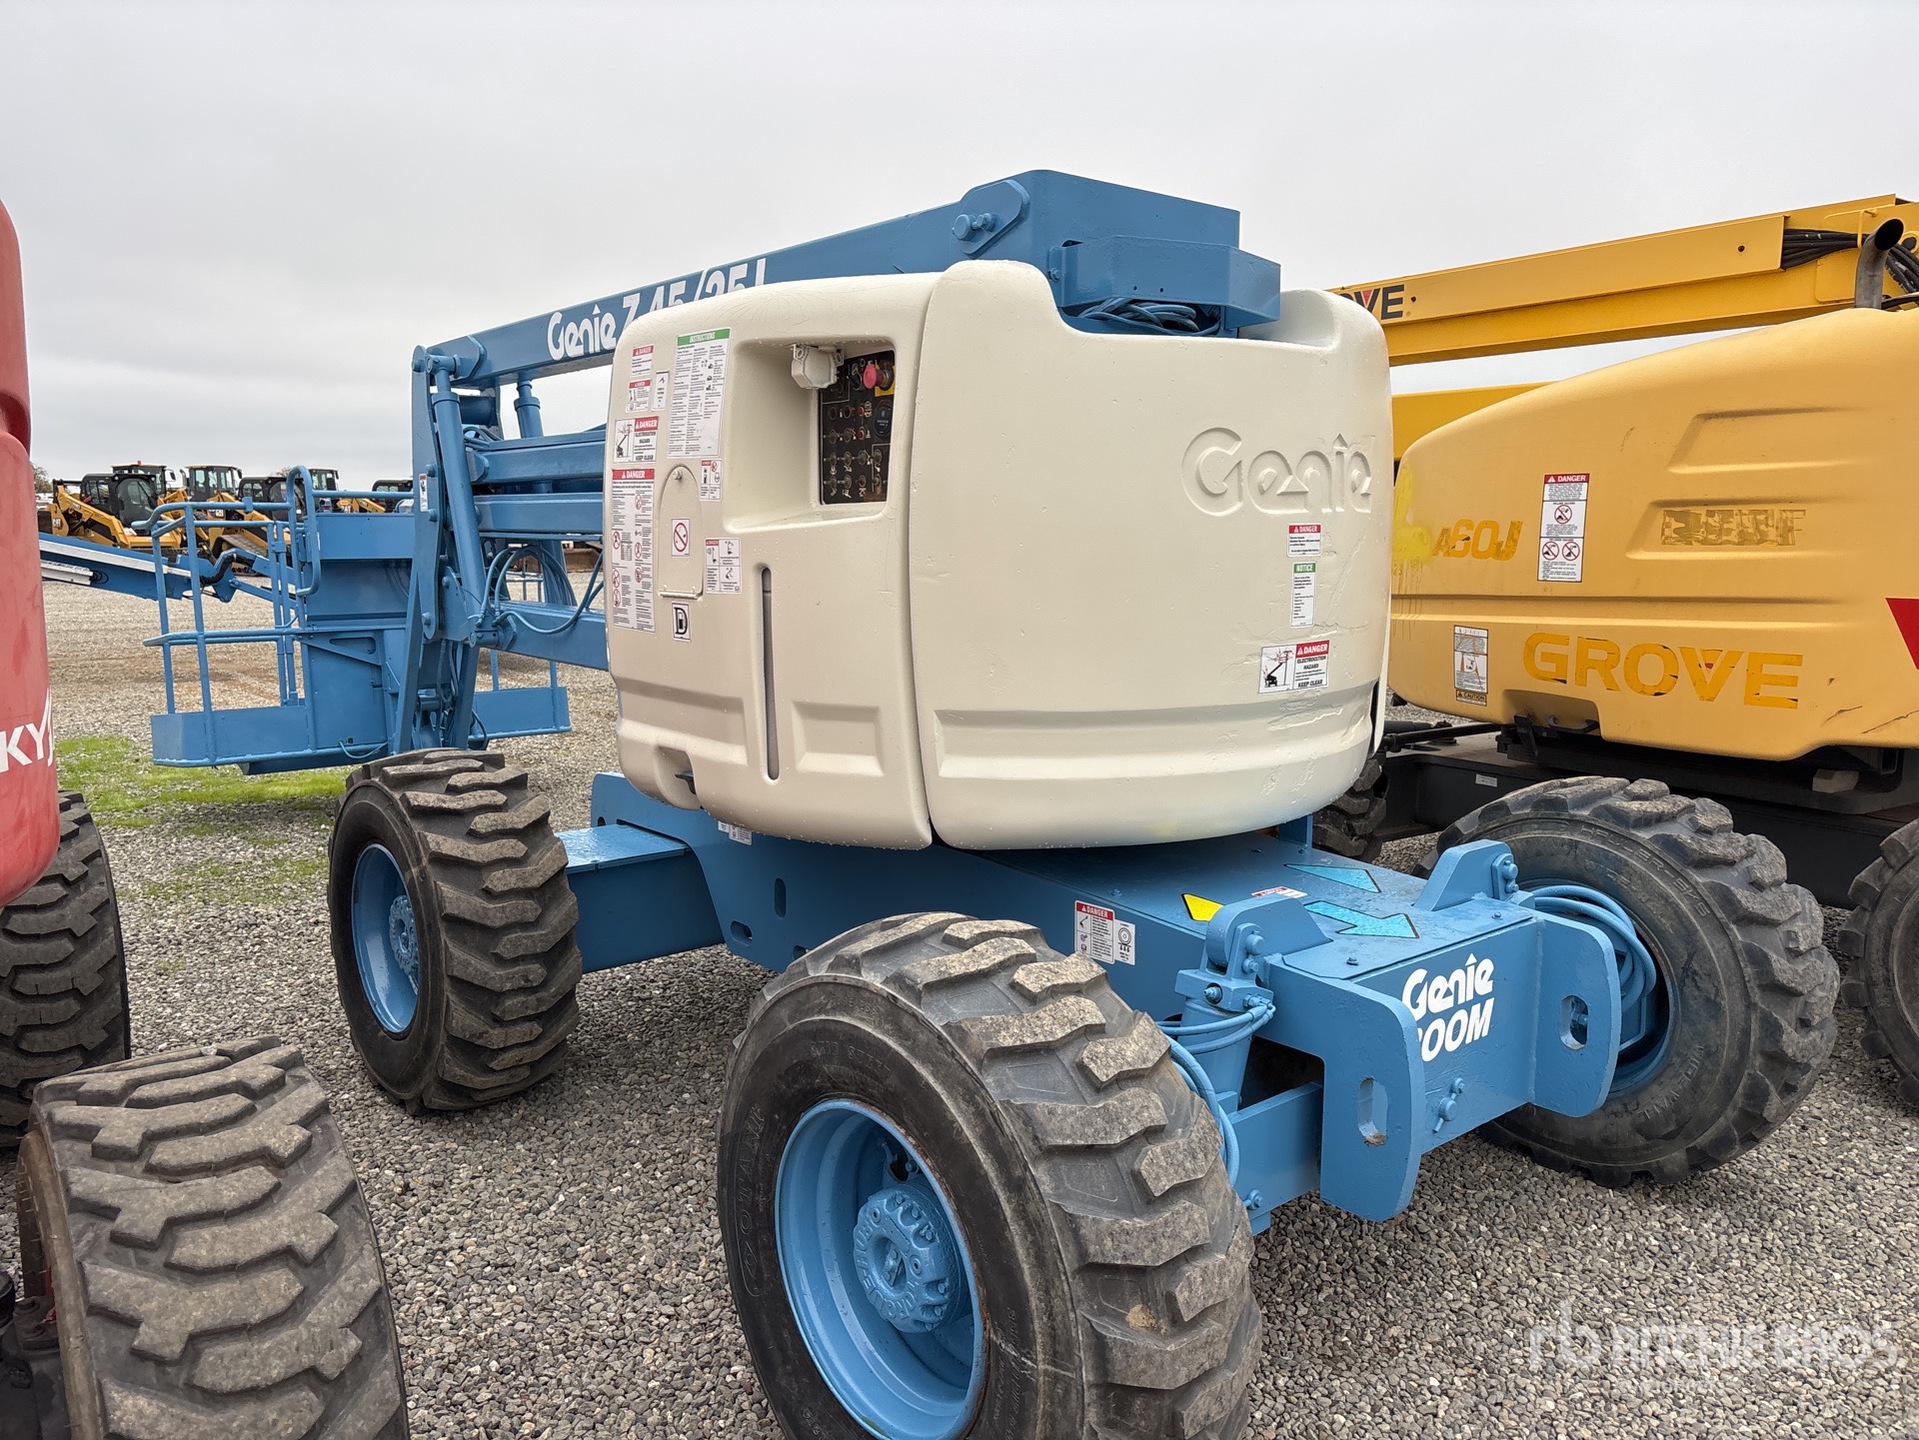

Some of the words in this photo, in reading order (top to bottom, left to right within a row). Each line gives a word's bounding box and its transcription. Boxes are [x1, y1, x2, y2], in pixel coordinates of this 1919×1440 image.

[547, 304, 617, 361] Genie
[626, 470, 646, 479] DANGER
[1181, 432, 1372, 517] Genie
[1557, 475, 1586, 483] DANGER
[1296, 564, 1314, 572] NOTICE
[1303, 643, 1328, 655] DANGER
[1523, 632, 1803, 710] GROVE
[1086, 905, 1109, 918] DANGER
[1401, 952, 1495, 1022] Genie
[1417, 997, 1495, 1062] OOM
